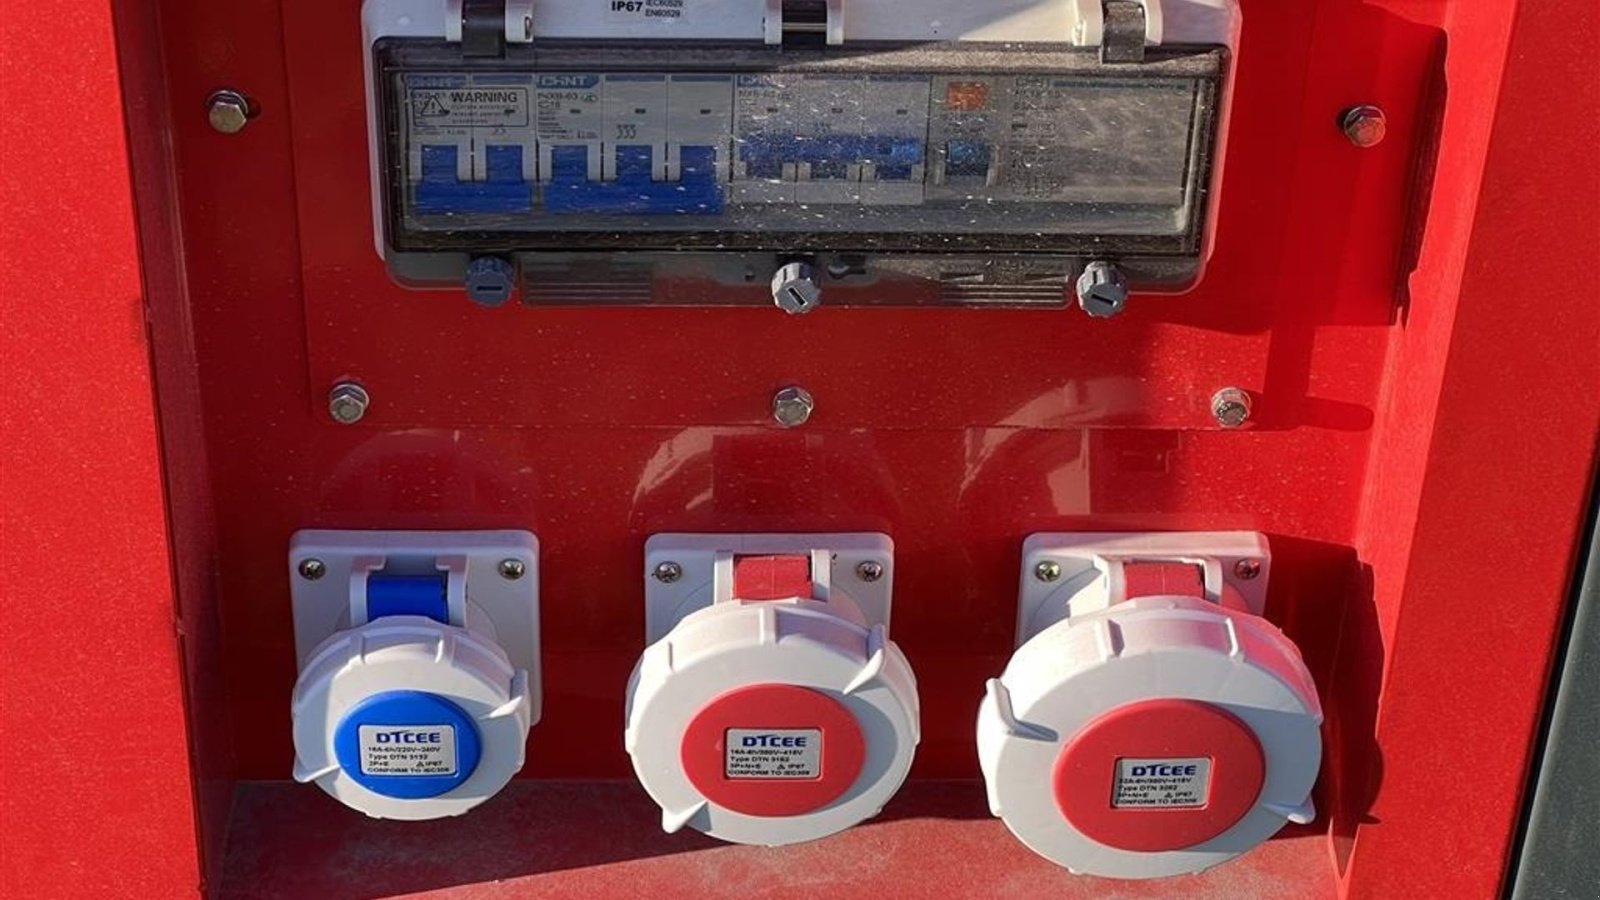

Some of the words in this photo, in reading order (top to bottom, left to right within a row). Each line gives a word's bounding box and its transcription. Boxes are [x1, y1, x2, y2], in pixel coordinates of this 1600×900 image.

[611, 1, 643, 12] IP67
[450, 91, 518, 103] WARNING
[376, 730, 441, 743] DTCEE
[742, 735, 806, 747] DTCEE
[1131, 764, 1196, 776] DTCEE
